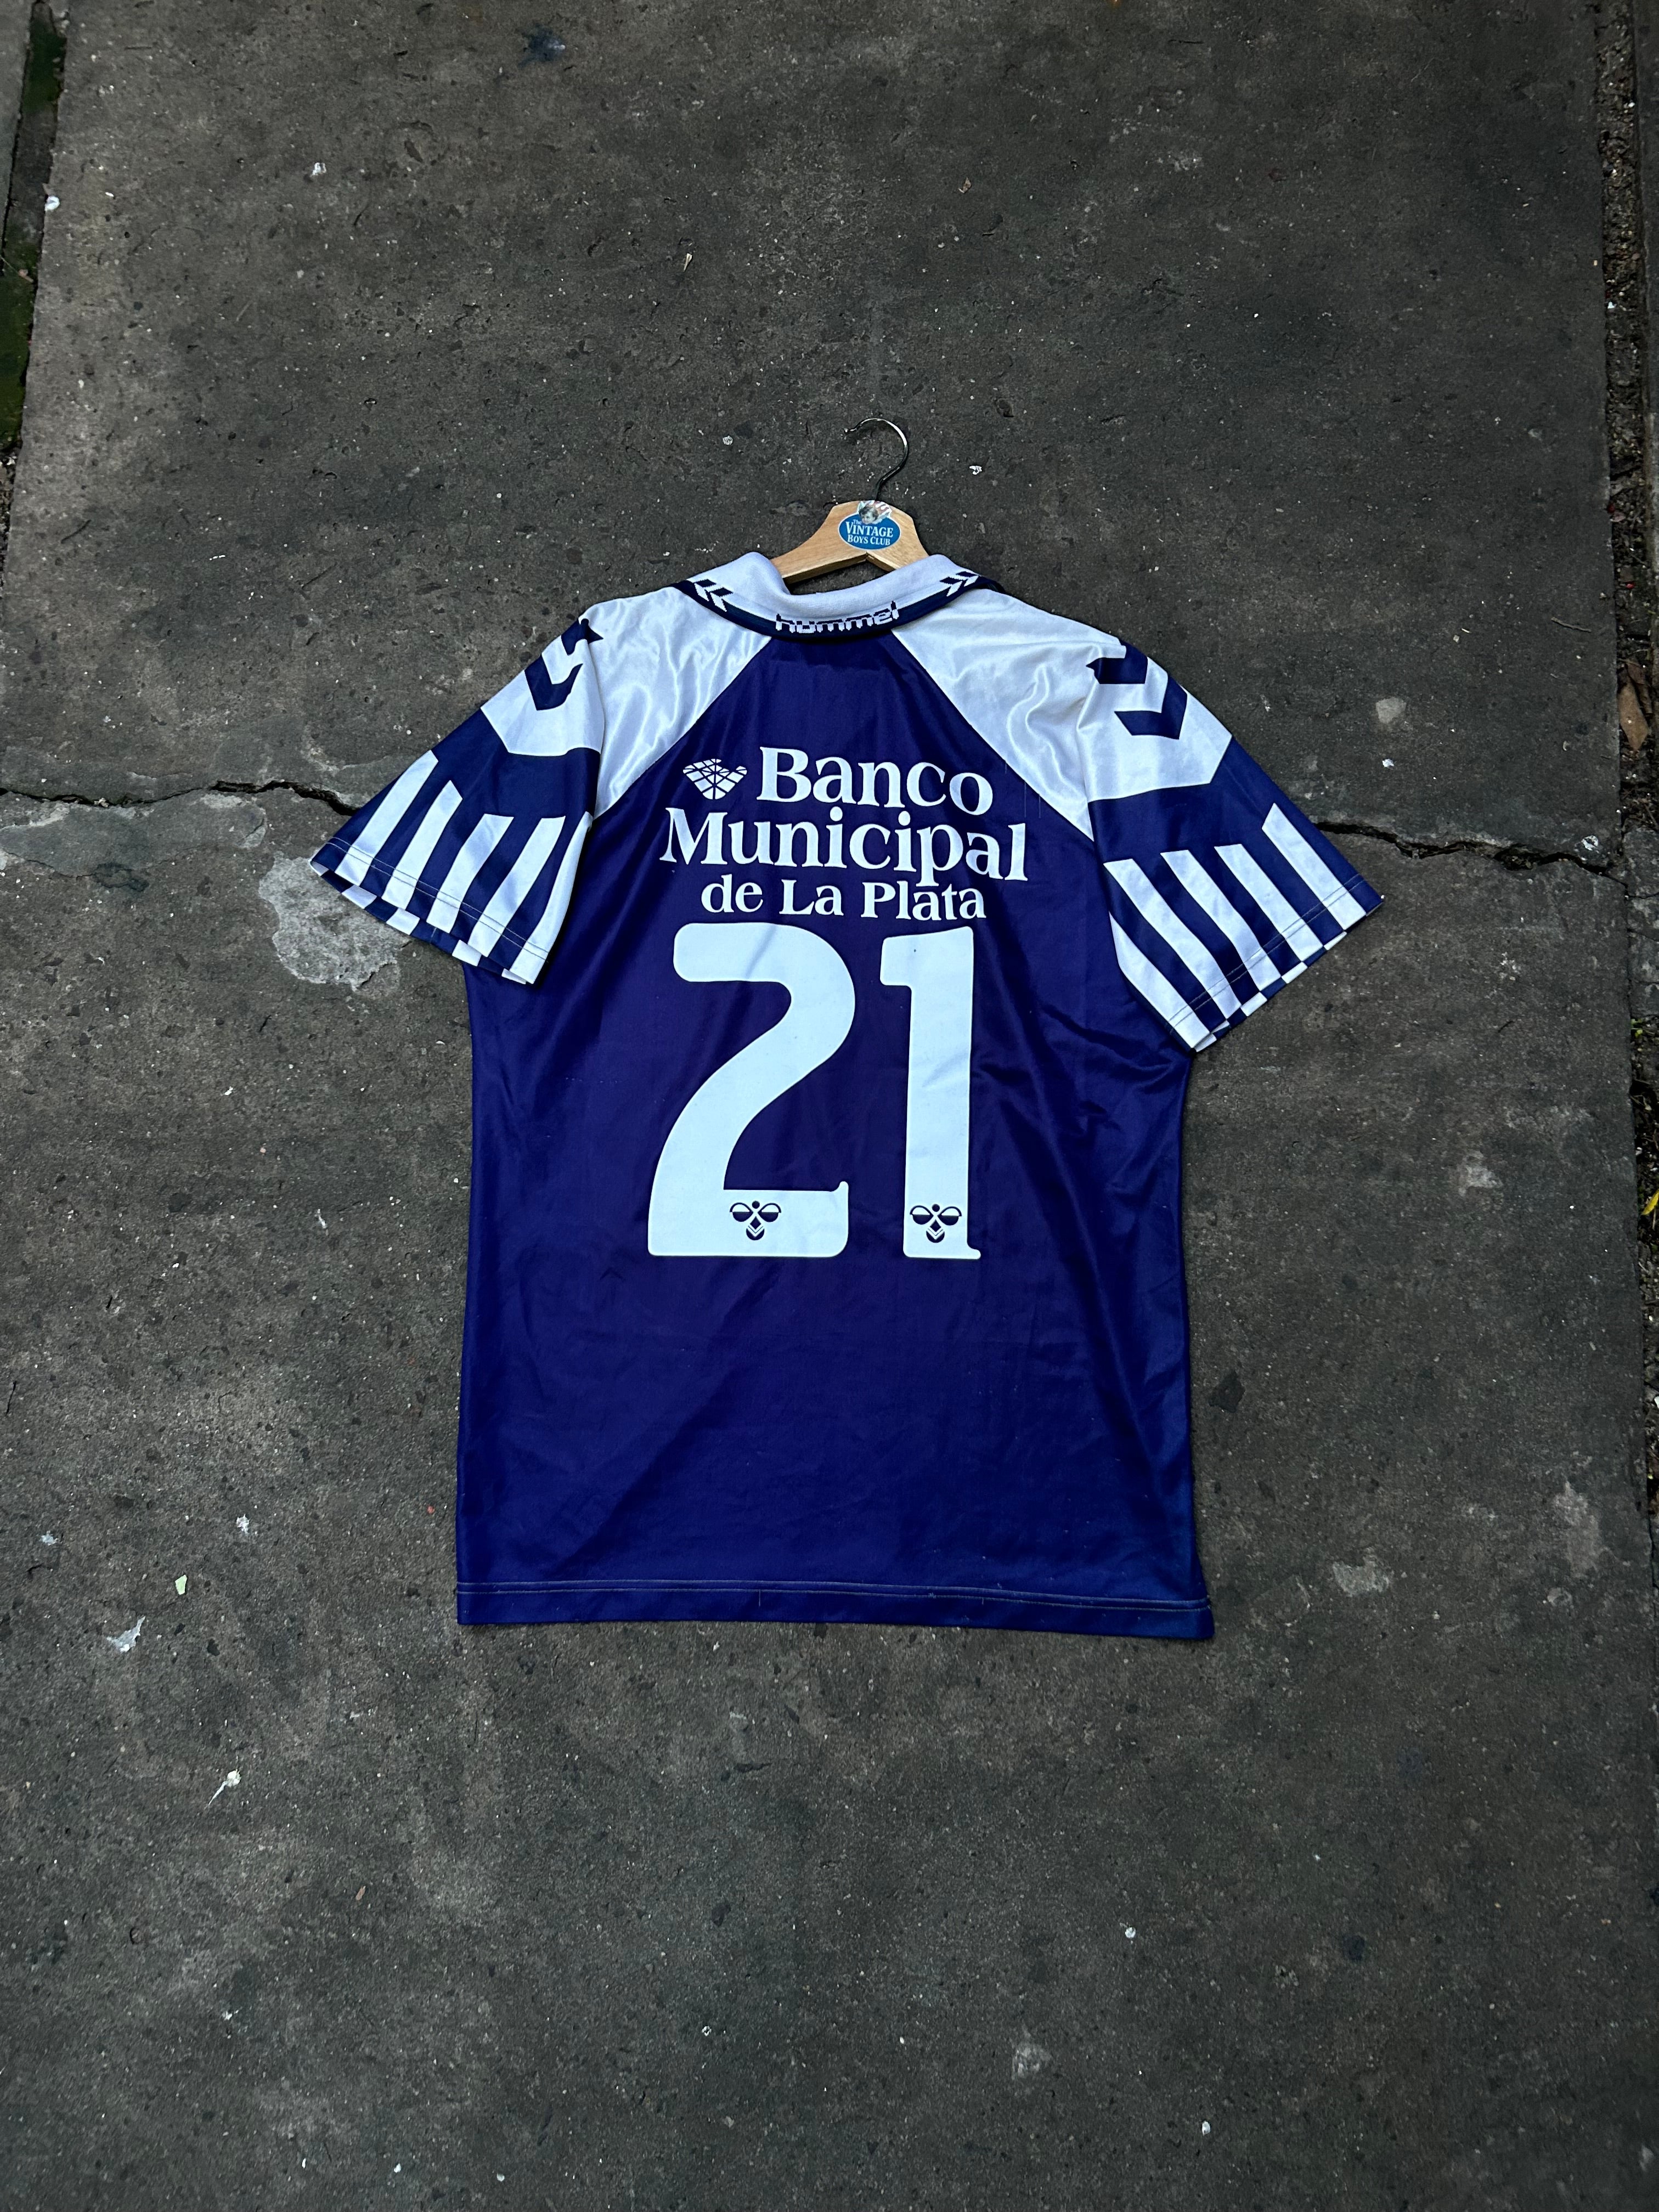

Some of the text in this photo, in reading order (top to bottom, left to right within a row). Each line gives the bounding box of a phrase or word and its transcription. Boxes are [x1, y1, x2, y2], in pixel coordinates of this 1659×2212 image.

[845, 521, 894, 538] VINTAGE
[848, 534, 891, 546] BOYS CLUB
[775, 601, 900, 634] hummel
[757, 746, 994, 816] Banco
[659, 806, 1028, 888] Municipal
[701, 873, 986, 921] de La Plata
[647, 922, 981, 1259] 21
